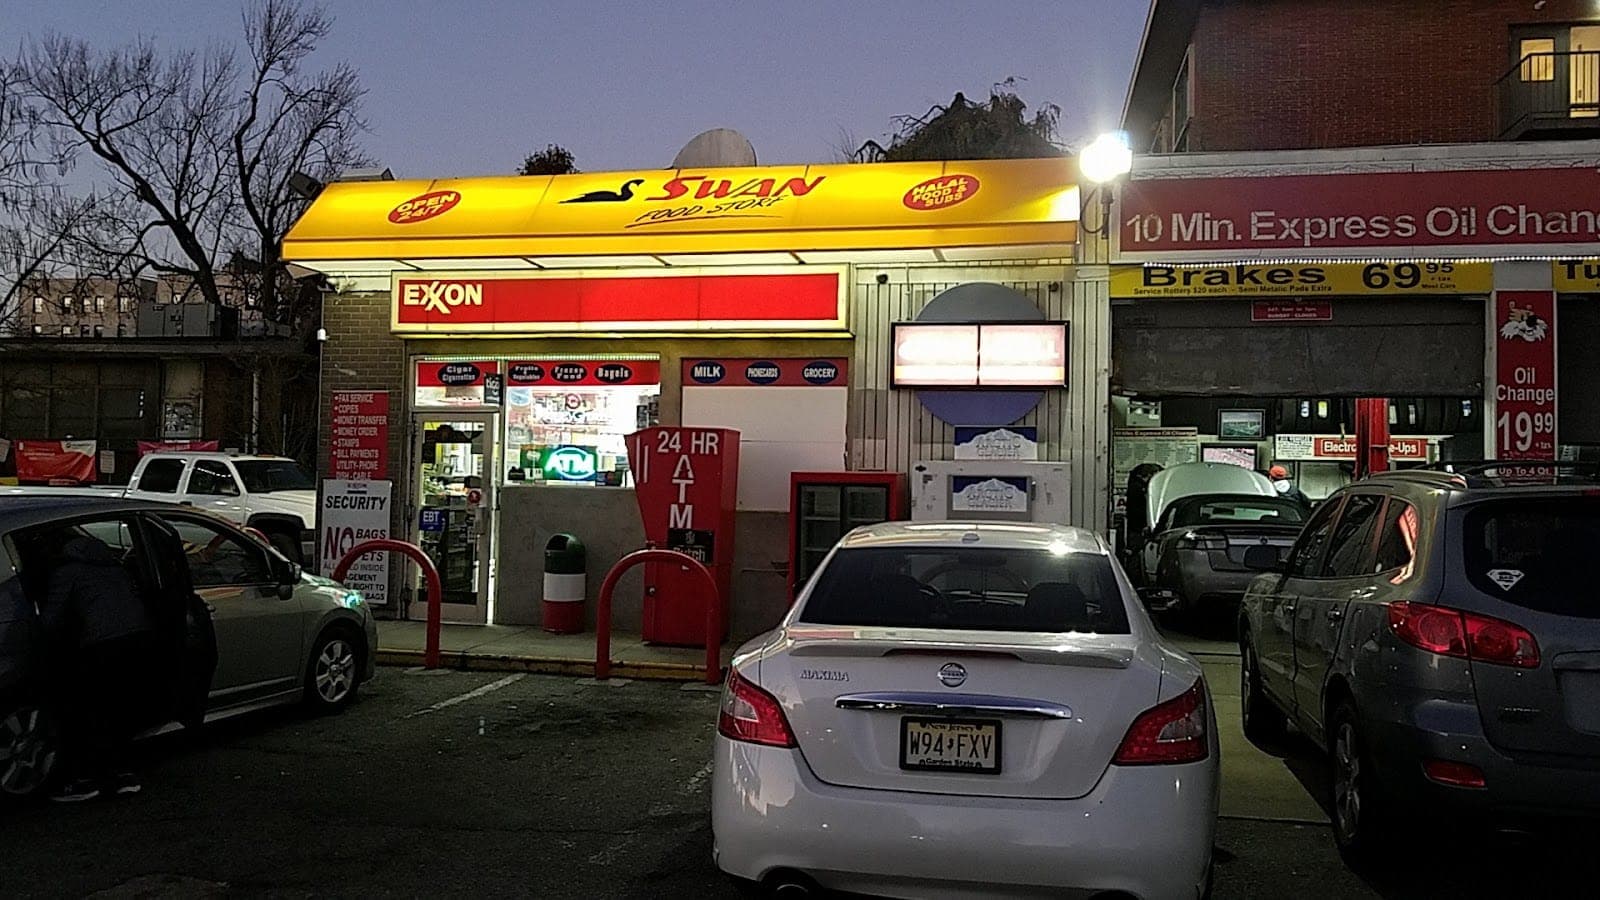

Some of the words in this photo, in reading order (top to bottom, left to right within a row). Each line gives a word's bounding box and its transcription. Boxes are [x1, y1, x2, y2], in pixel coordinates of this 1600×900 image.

[645, 176, 826, 201] SWAN
[912, 177, 968, 196] HALAL
[913, 188, 952, 203] FOOD
[956, 184, 967, 193] &
[397, 193, 457, 213] OPEN
[635, 205, 703, 222] FOOD
[707, 195, 788, 214] STORE
[925, 193, 963, 207] SUBS
[396, 204, 443, 222] 24/7
[1126, 213, 1163, 243] 10
[1171, 212, 1242, 242] Min.
[1250, 210, 1417, 247] Express
[1426, 206, 1477, 237] Oil
[1487, 204, 1600, 239] Chan
[1143, 264, 1326, 287] Brakes
[1362, 262, 1421, 289] 69
[1426, 262, 1454, 274] 95
[403, 281, 483, 314] EXXON
[446, 366, 473, 374] Cigar
[598, 367, 630, 380] Bagels
[694, 366, 721, 378] MILK
[804, 367, 836, 379] GROCERY
[1514, 366, 1536, 384] Oil
[338, 393, 350, 403] FAX
[350, 393, 374, 403] SERVICE
[1496, 384, 1554, 405] Change
[338, 404, 359, 414] COPIES
[337, 415, 357, 425] MONEY
[358, 415, 387, 425] TRANSFER
[337, 427, 357, 436] MONEY
[358, 427, 378, 436] ORDER
[1498, 411, 1533, 452] 19
[1534, 412, 1554, 433] 99
[337, 438, 360, 448] STAMPS
[657, 431, 682, 453] 24
[691, 431, 719, 456] HR
[337, 449, 349, 458] BILL
[350, 448, 379, 459] PAYMENTS
[545, 452, 596, 475] ATM
[1499, 466, 1513, 476] Up
[1515, 466, 1527, 475] To
[1528, 466, 1535, 475] 4
[669, 454, 694, 529] ATM
[325, 495, 387, 511] SECURITY
[423, 511, 440, 523] EBT
[324, 526, 355, 560] NO
[356, 528, 386, 540] BAGS
[362, 551, 384, 562] ETS
[800, 669, 850, 682] MAXIMA
[910, 731, 944, 756] W94
[957, 733, 992, 759] FXV
